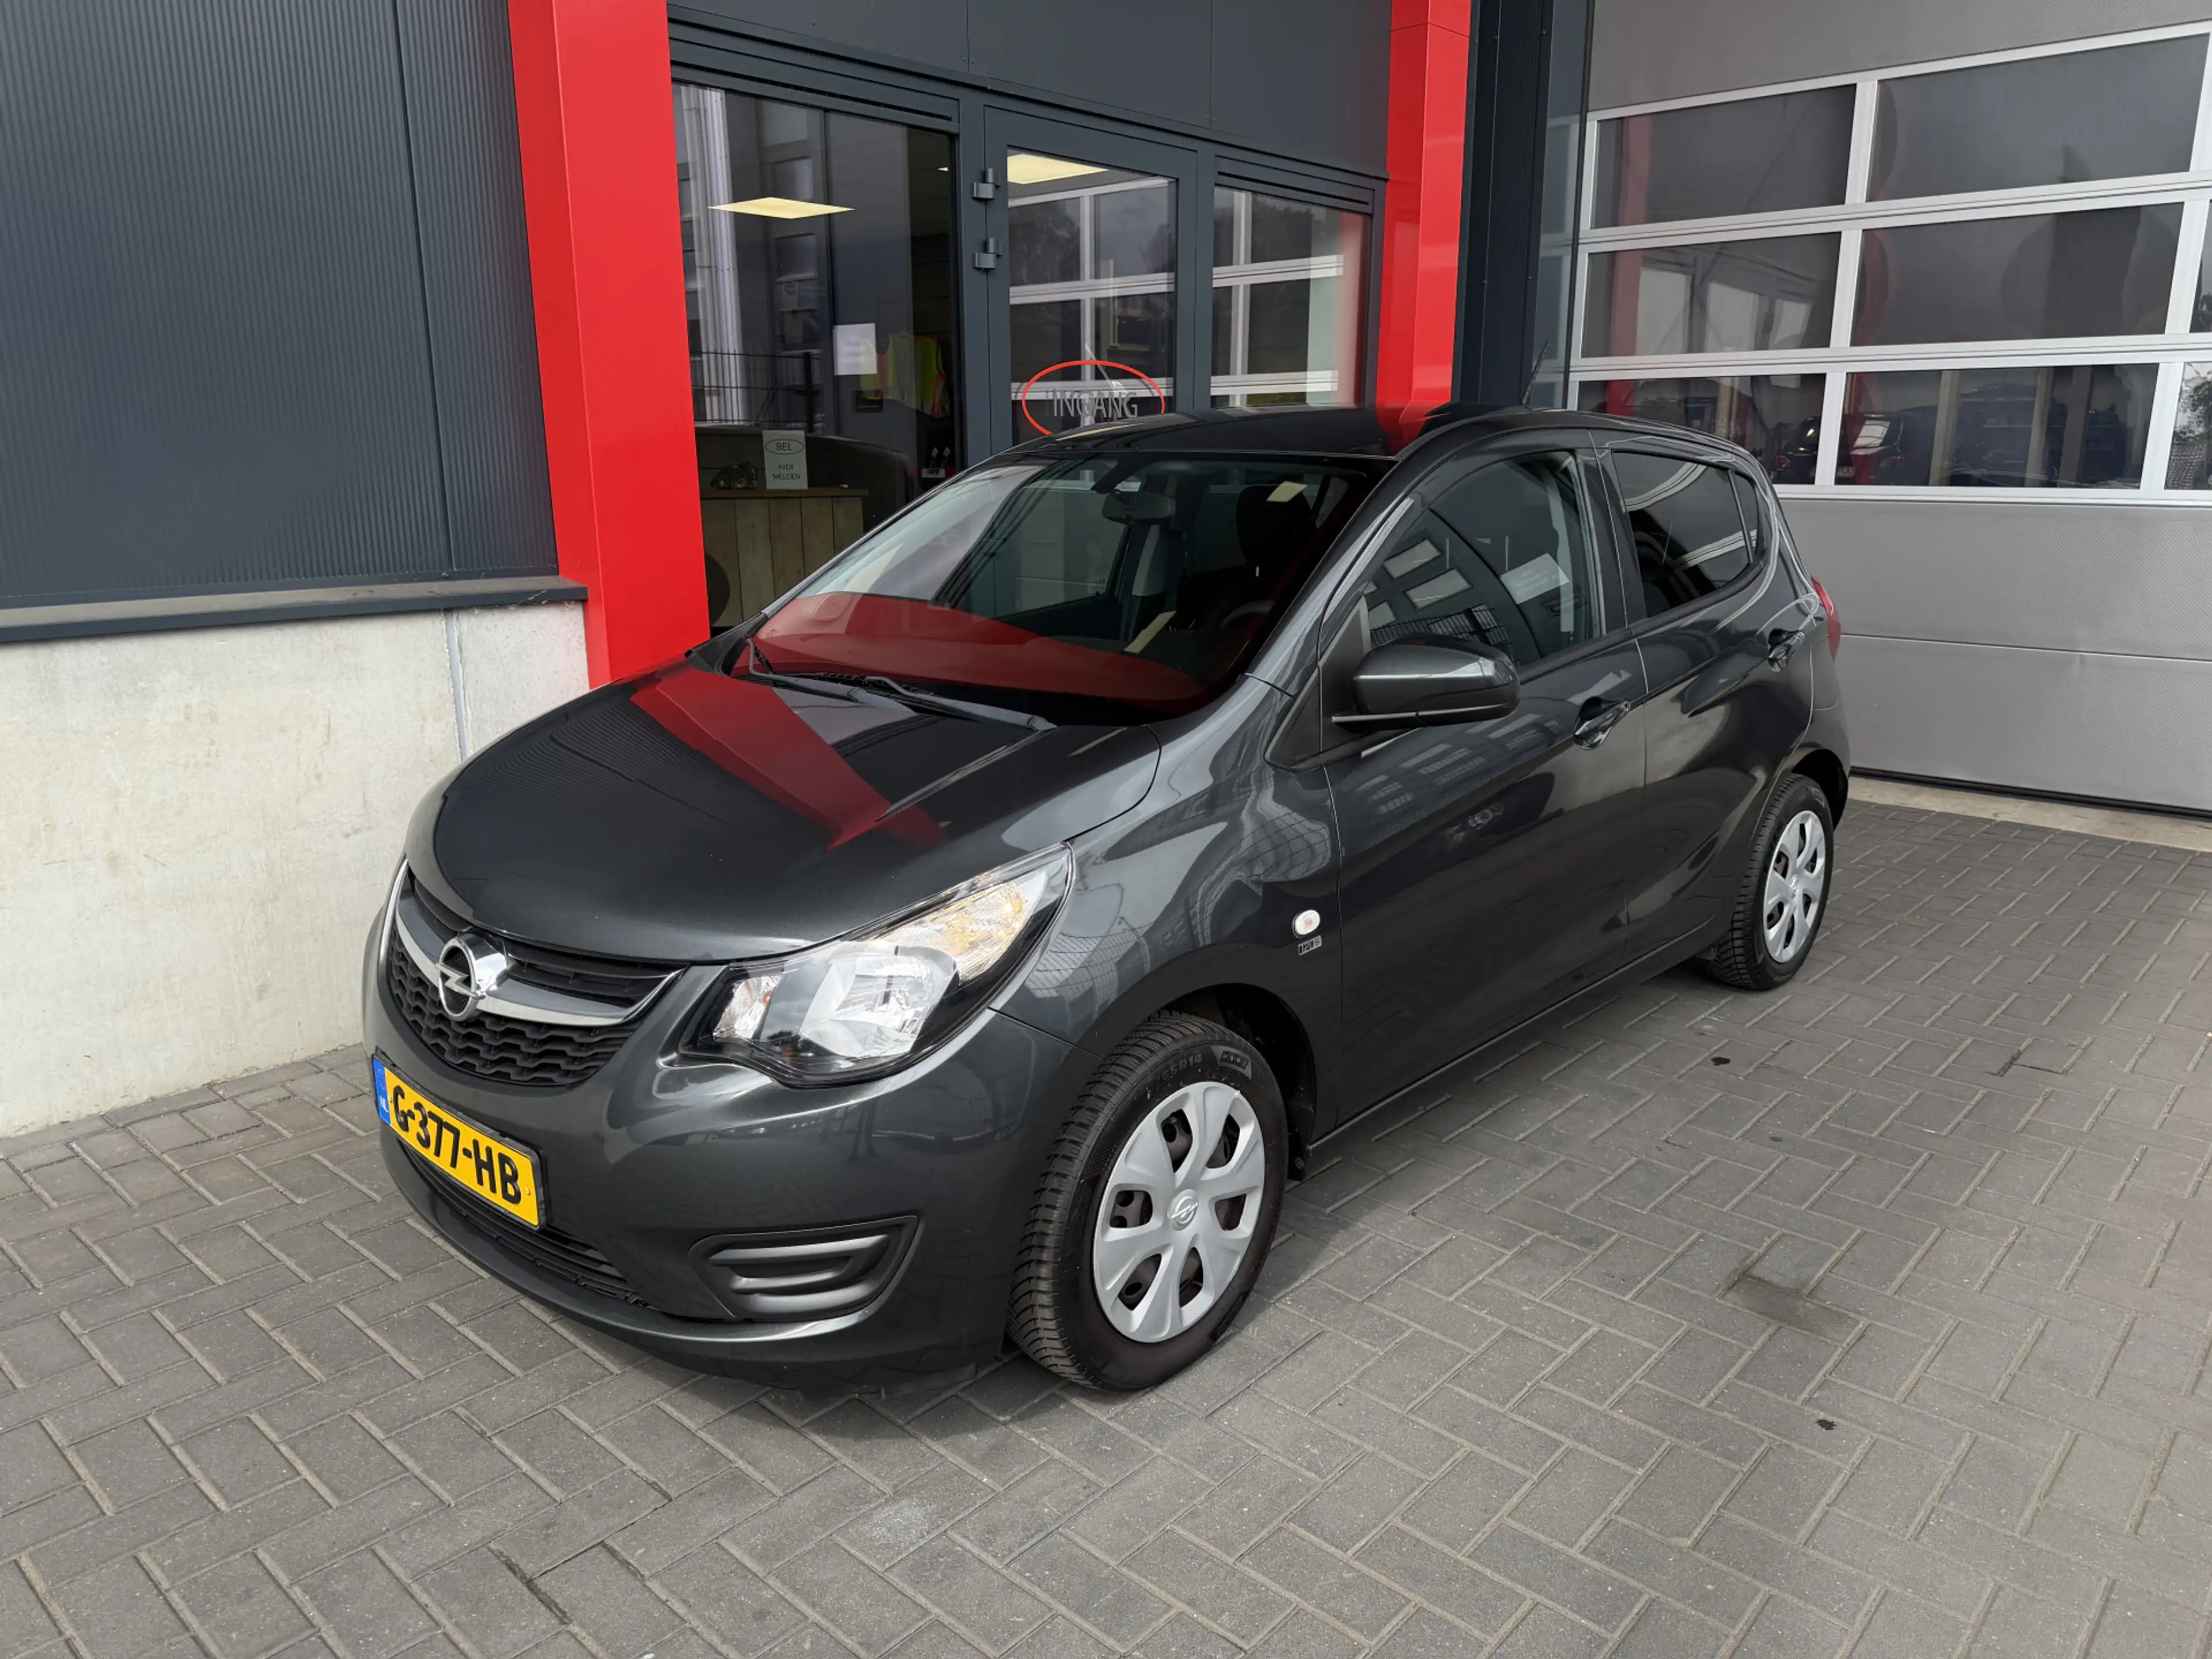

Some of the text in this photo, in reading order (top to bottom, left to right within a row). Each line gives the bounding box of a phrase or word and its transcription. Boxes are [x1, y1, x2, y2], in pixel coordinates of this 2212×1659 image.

[1053, 389, 1138, 418] INGANG
[776, 442, 793, 451] BEL
[392, 1085, 522, 1205] G-377-HB
